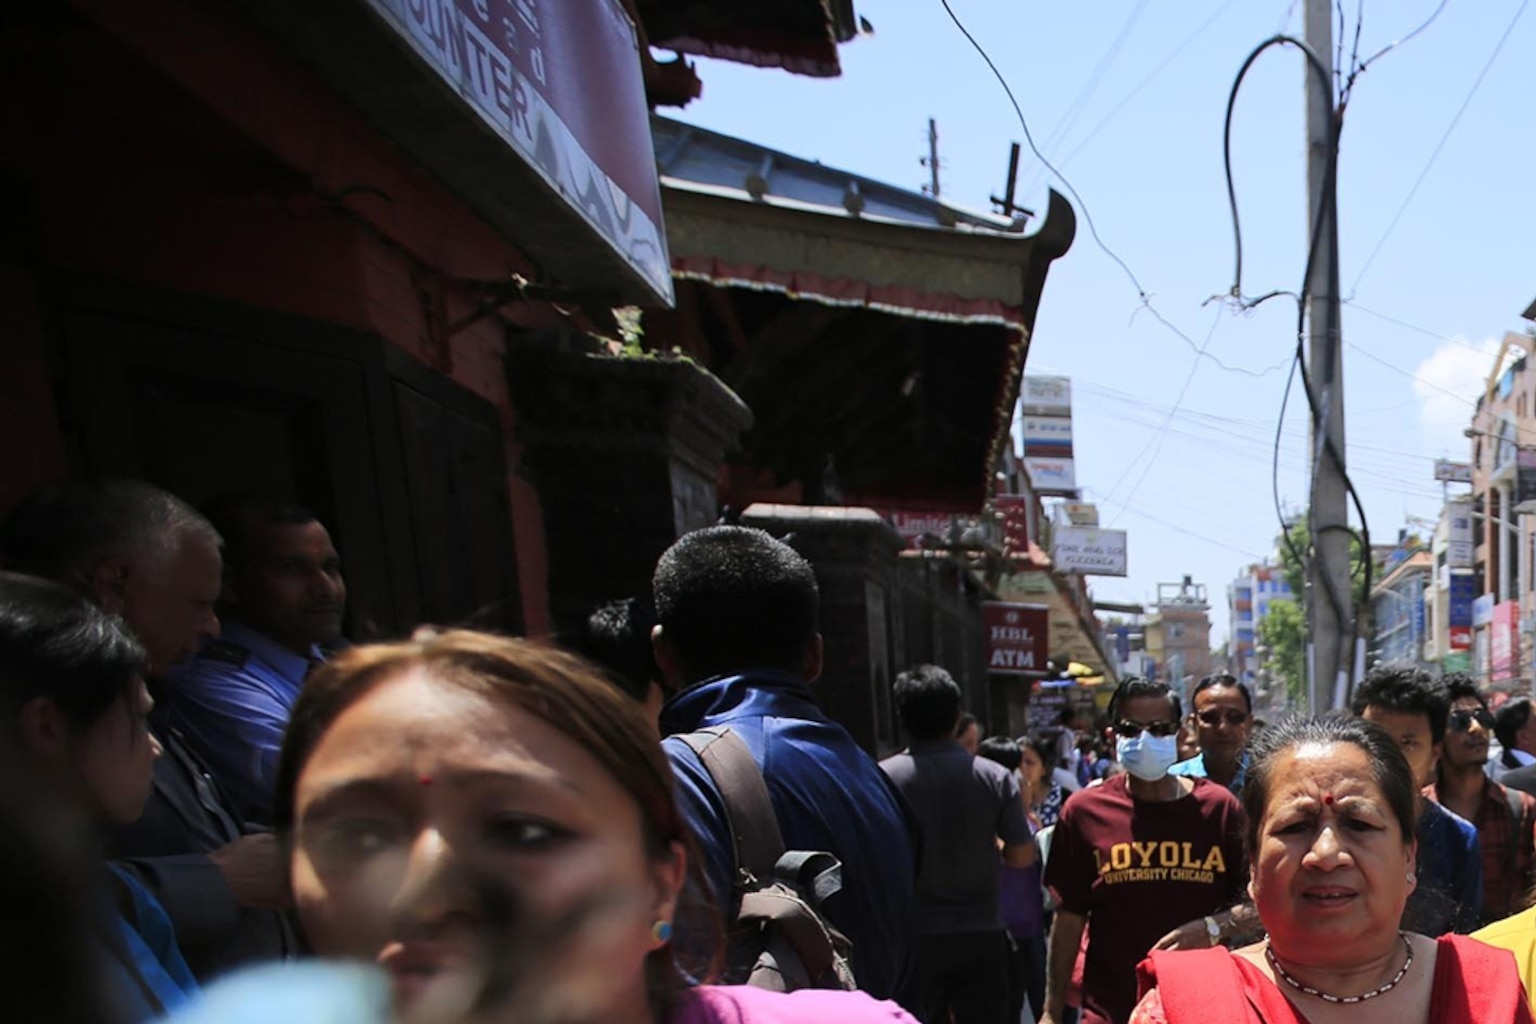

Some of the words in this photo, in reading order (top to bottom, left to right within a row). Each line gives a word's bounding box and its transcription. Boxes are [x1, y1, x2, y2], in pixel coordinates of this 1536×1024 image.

[990, 626, 1034, 641] HBL
[989, 648, 1035, 667] ATM
[1092, 840, 1226, 873] LOYOLA
[1103, 867, 1169, 885] UNIVERSITY
[1170, 867, 1215, 884] CHICAGO
